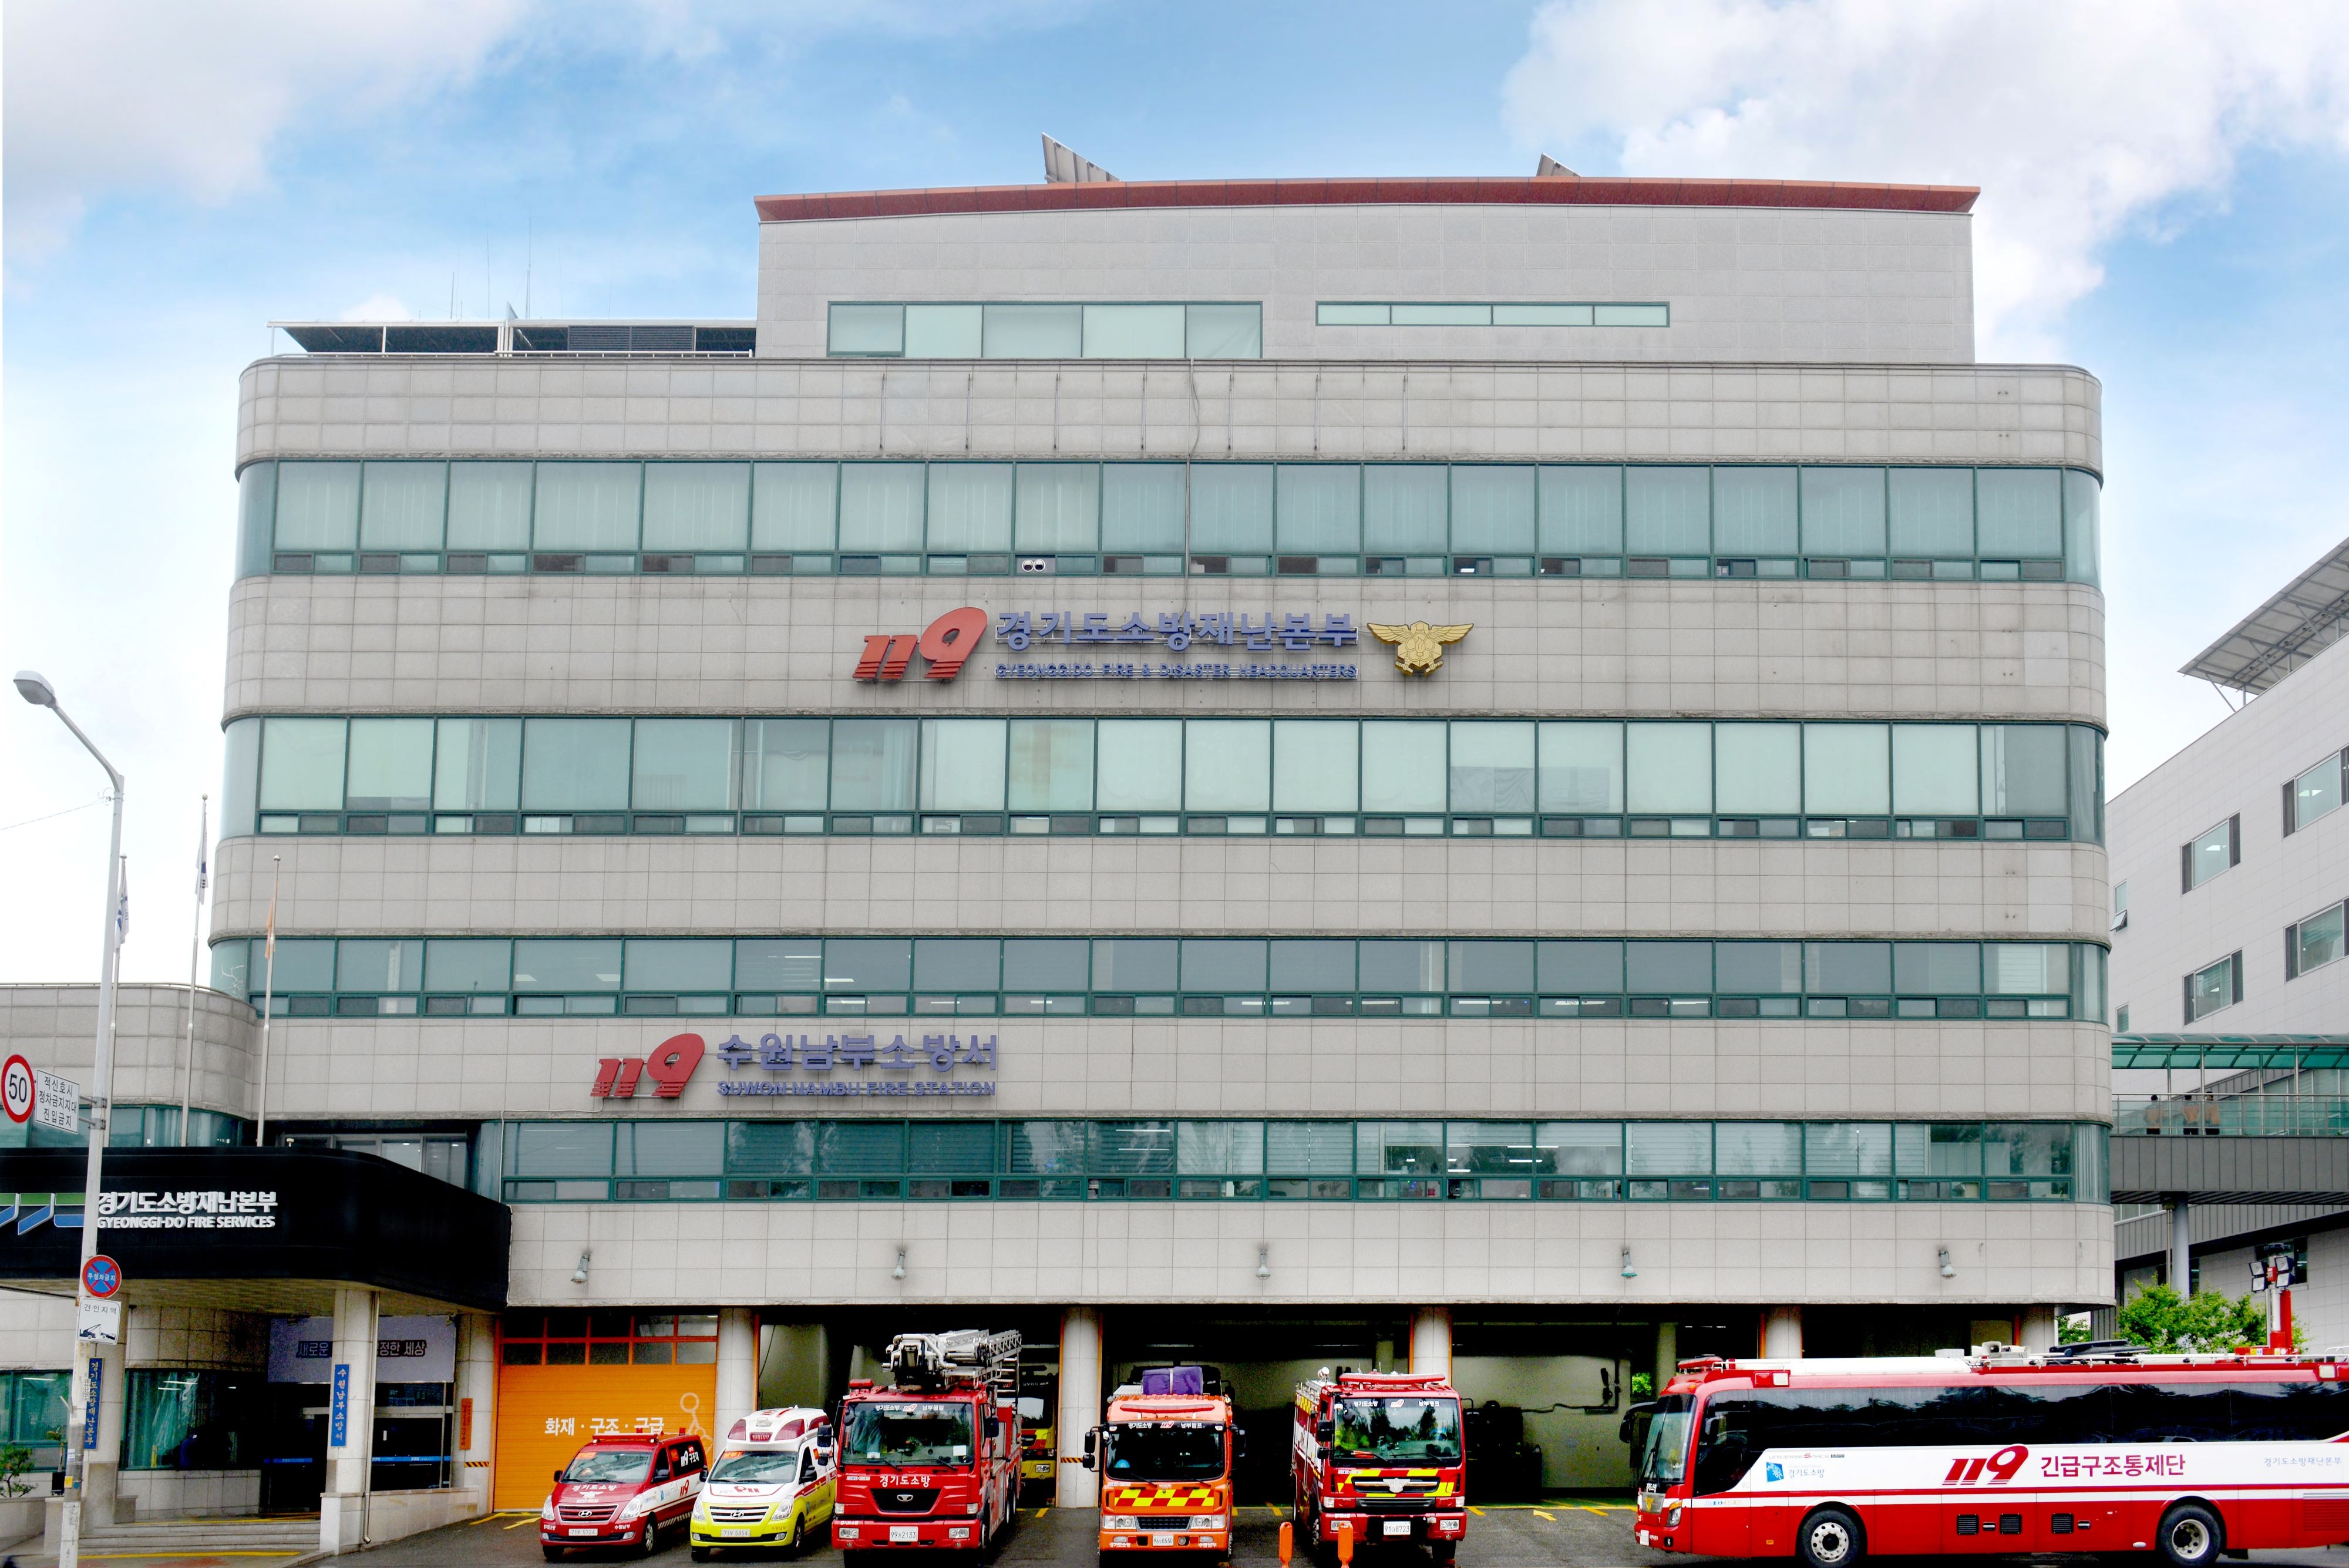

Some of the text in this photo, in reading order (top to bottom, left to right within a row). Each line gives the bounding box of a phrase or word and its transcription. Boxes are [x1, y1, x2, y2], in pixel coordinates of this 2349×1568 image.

[852, 607, 1357, 679] 119 경기도소방재난본부
[997, 663, 1357, 678] GYEONGGIDO FIRE & DISASTER HEADQUARTERS
[590, 1033, 997, 1097] 119 수원남부소방서
[9, 1074, 27, 1103] 50
[45, 1076, 73, 1097] 적신호시
[717, 1081, 996, 1096] SUWON NAMBU FIRE STATION
[39, 1091, 77, 1113] 정차금지지대
[43, 1108, 72, 1128] 진입금지
[98, 1192, 278, 1214] 경기도소방재난본부
[97, 1216, 275, 1228] GYEONGGI-DO FIRE SERVICES
[84, 1304, 116, 1314] 견인지역
[299, 1341, 426, 1357] 새로운 정한 세상
[85, 1361, 99, 1445] 경기도소방재난본부
[335, 1368, 346, 1441] 수원남부소방서
[545, 1417, 665, 1436] 화재 구조 구급
[1941, 1445, 2186, 1486] 119 긴급구조통제단
[2264, 1456, 2342, 1468] 경기도소방재난본부
[880, 1476, 930, 1488] 경기도소방
[1788, 1468, 1826, 1479] 경기도소방
